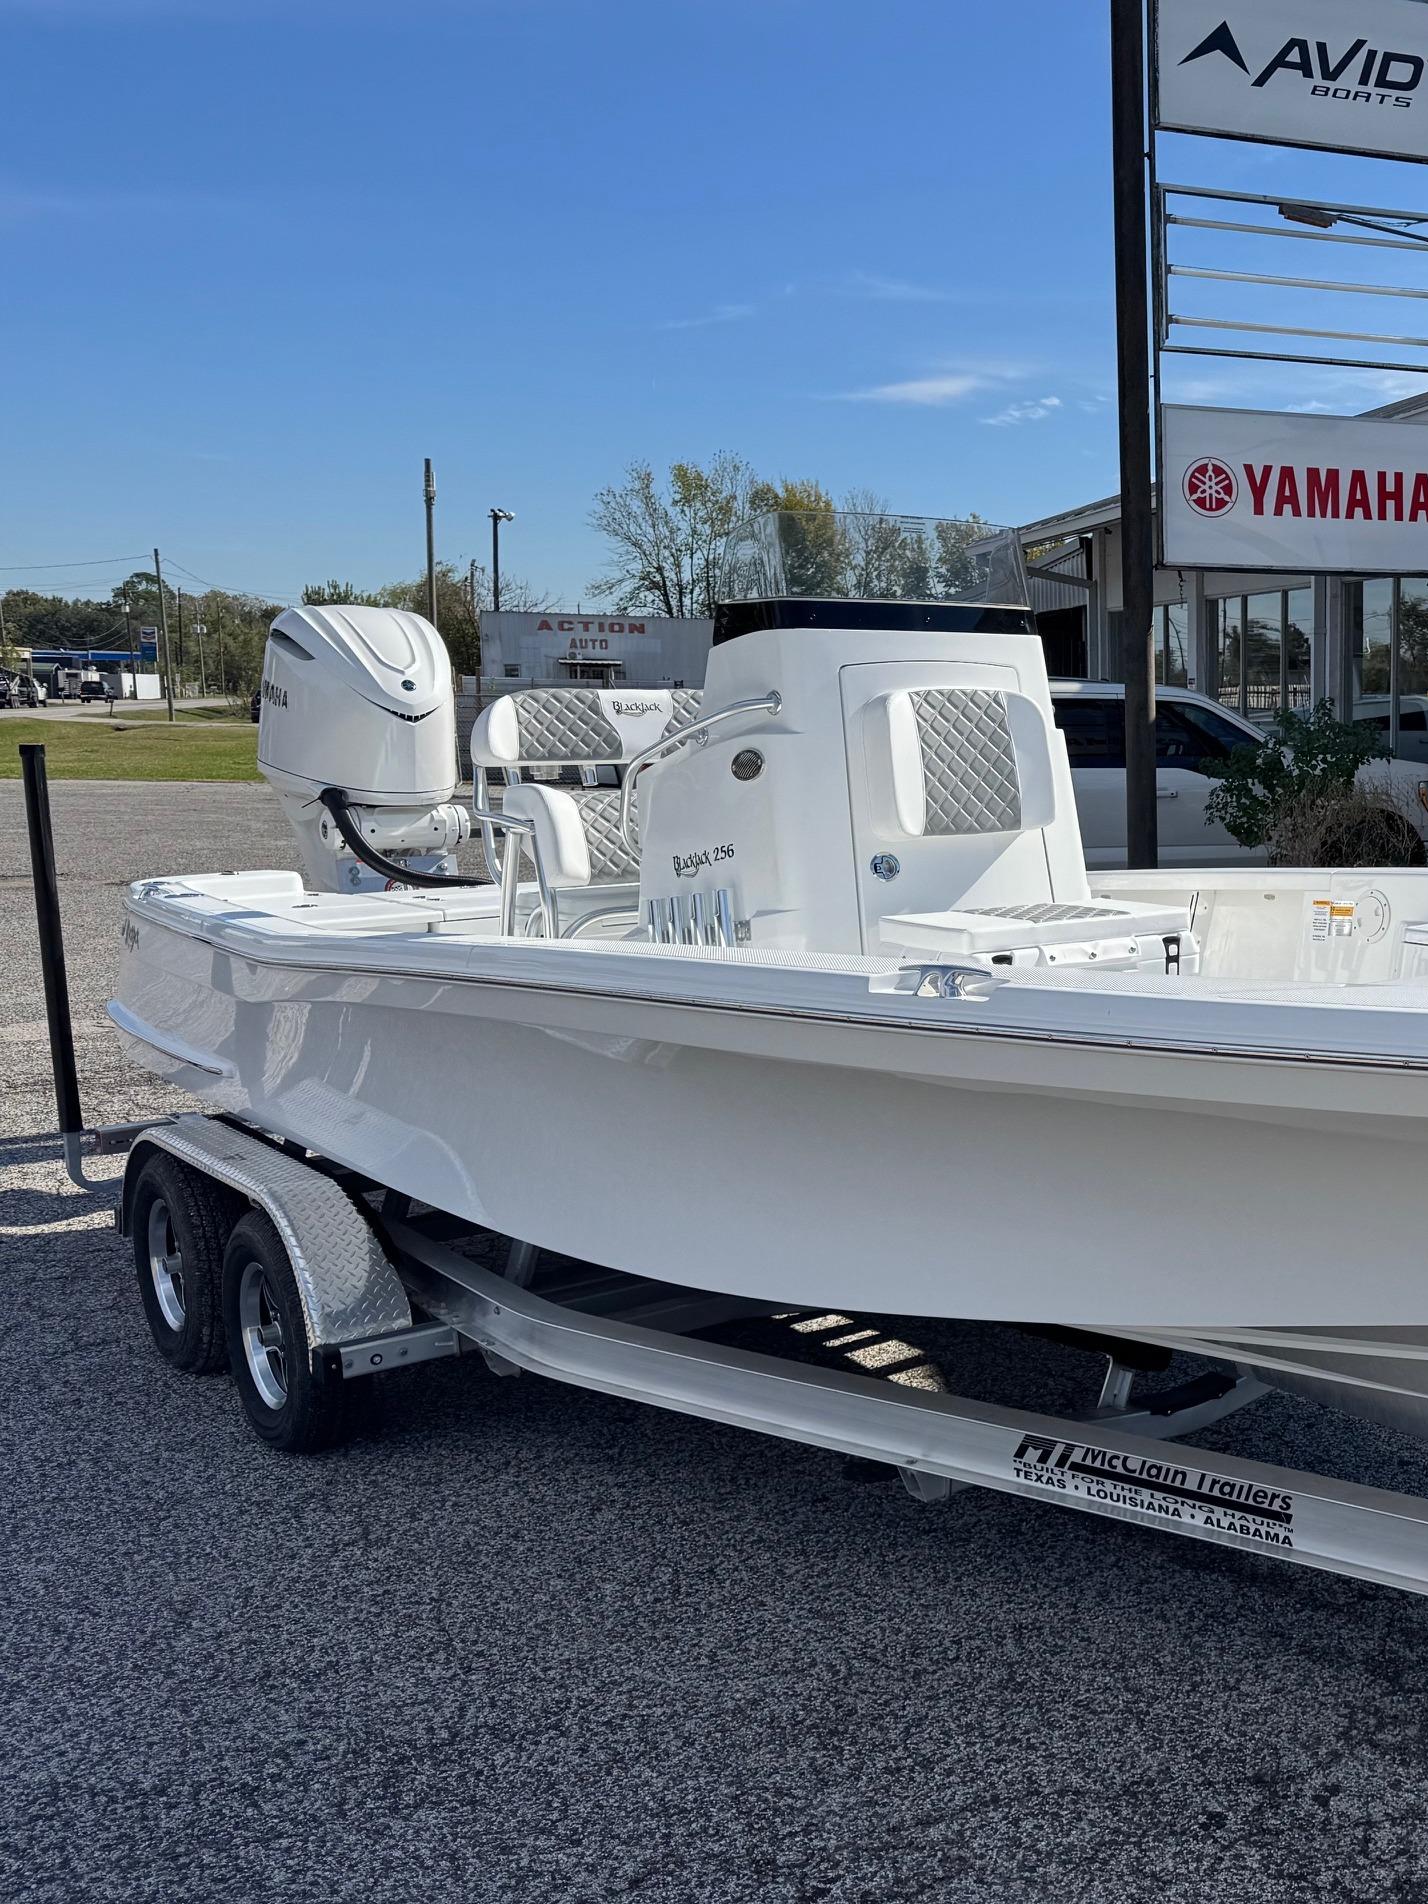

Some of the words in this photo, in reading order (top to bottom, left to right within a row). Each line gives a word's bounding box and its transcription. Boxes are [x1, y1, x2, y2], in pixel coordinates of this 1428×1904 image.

[1310, 85, 1413, 109] BOATS
[537, 619, 646, 635] ACTION
[569, 637, 609, 650] AUTO
[713, 843, 735, 861] 256
[1081, 1447, 1187, 1486] McClain
[1071, 1473, 1106, 1488] FOR
[1110, 1483, 1143, 1496] THE
[1150, 1492, 1215, 1515] LONG
[1013, 1467, 1067, 1489] TEXAS
[1086, 1486, 1182, 1519] LOUISIANA
[1203, 1515, 1293, 1548] ALABAMA
